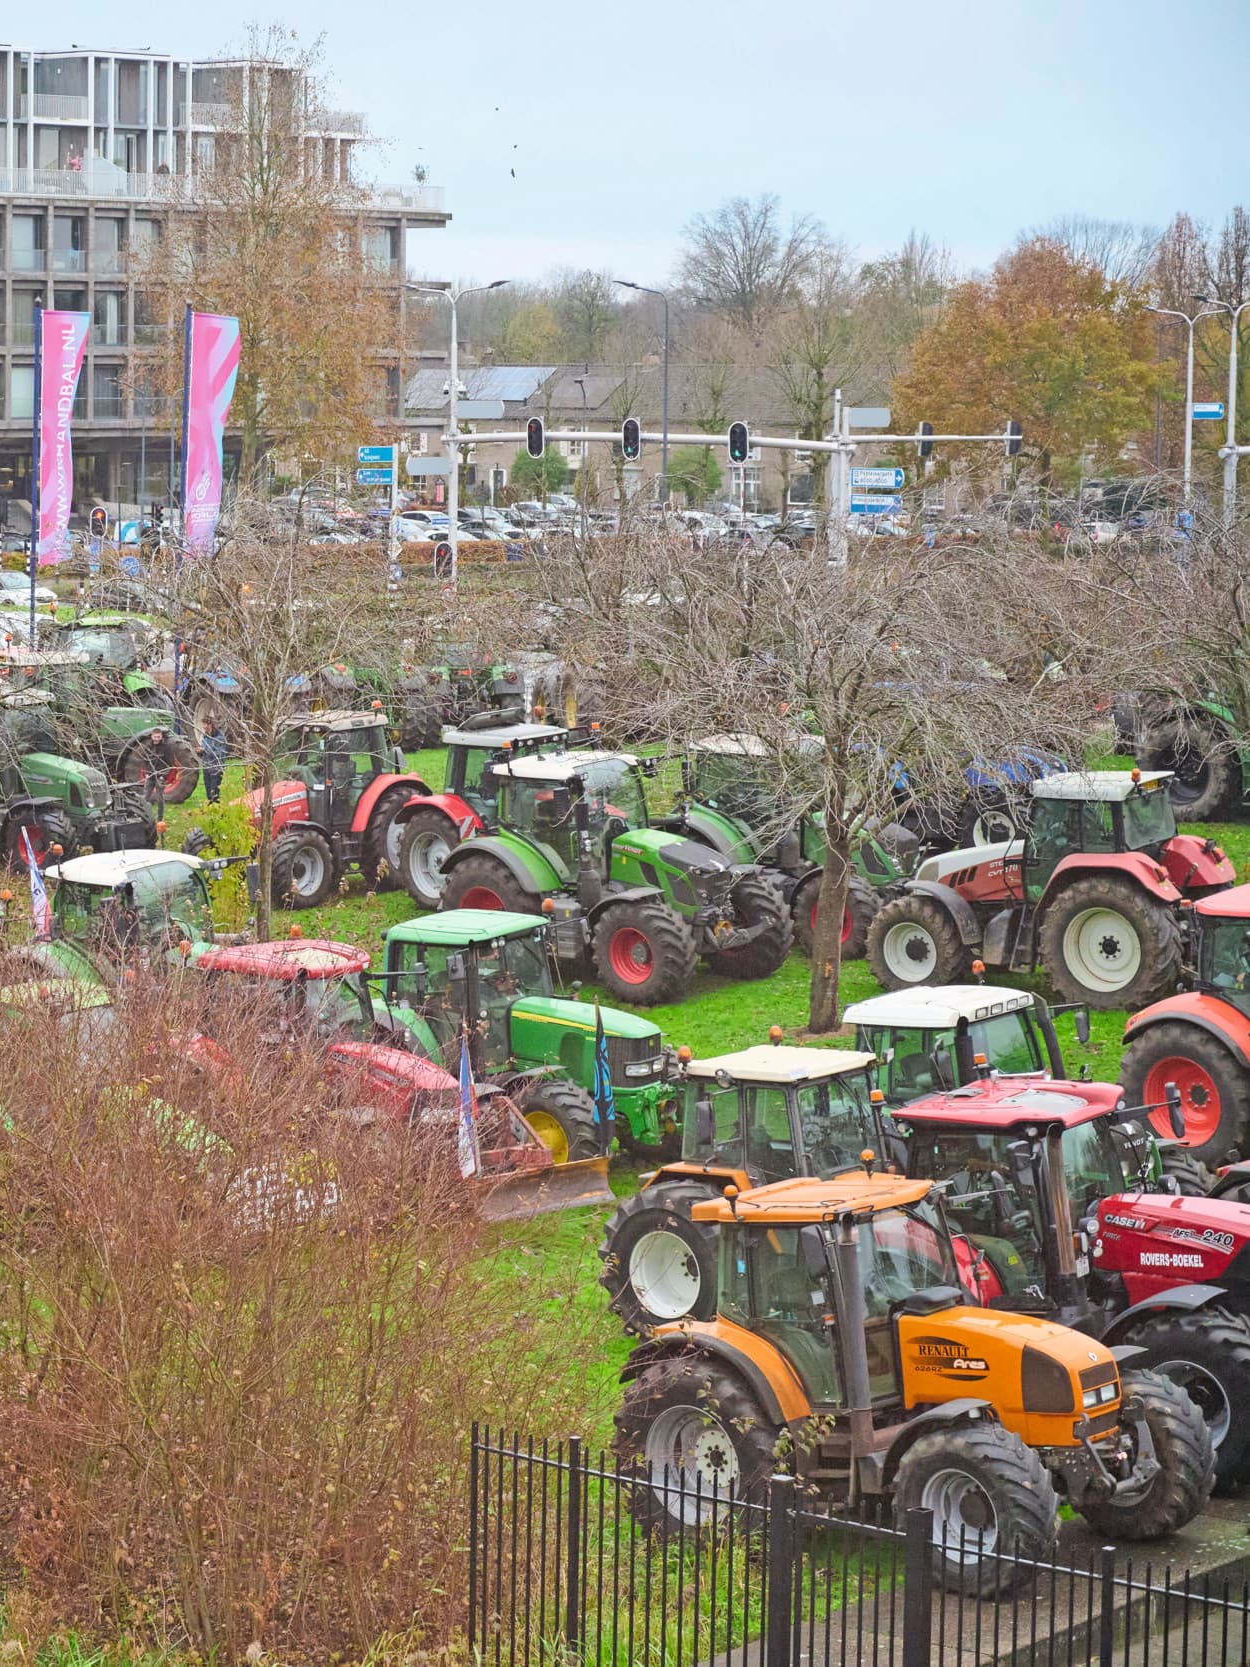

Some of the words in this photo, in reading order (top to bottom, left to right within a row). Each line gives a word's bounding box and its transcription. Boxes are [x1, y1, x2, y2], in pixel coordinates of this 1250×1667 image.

[1201, 1229, 1234, 1247] 240
[1140, 1252, 1204, 1268] ROVERS-BOEKEL
[918, 1344, 969, 1357] RENAULT
[953, 1358, 986, 1370] Ares
